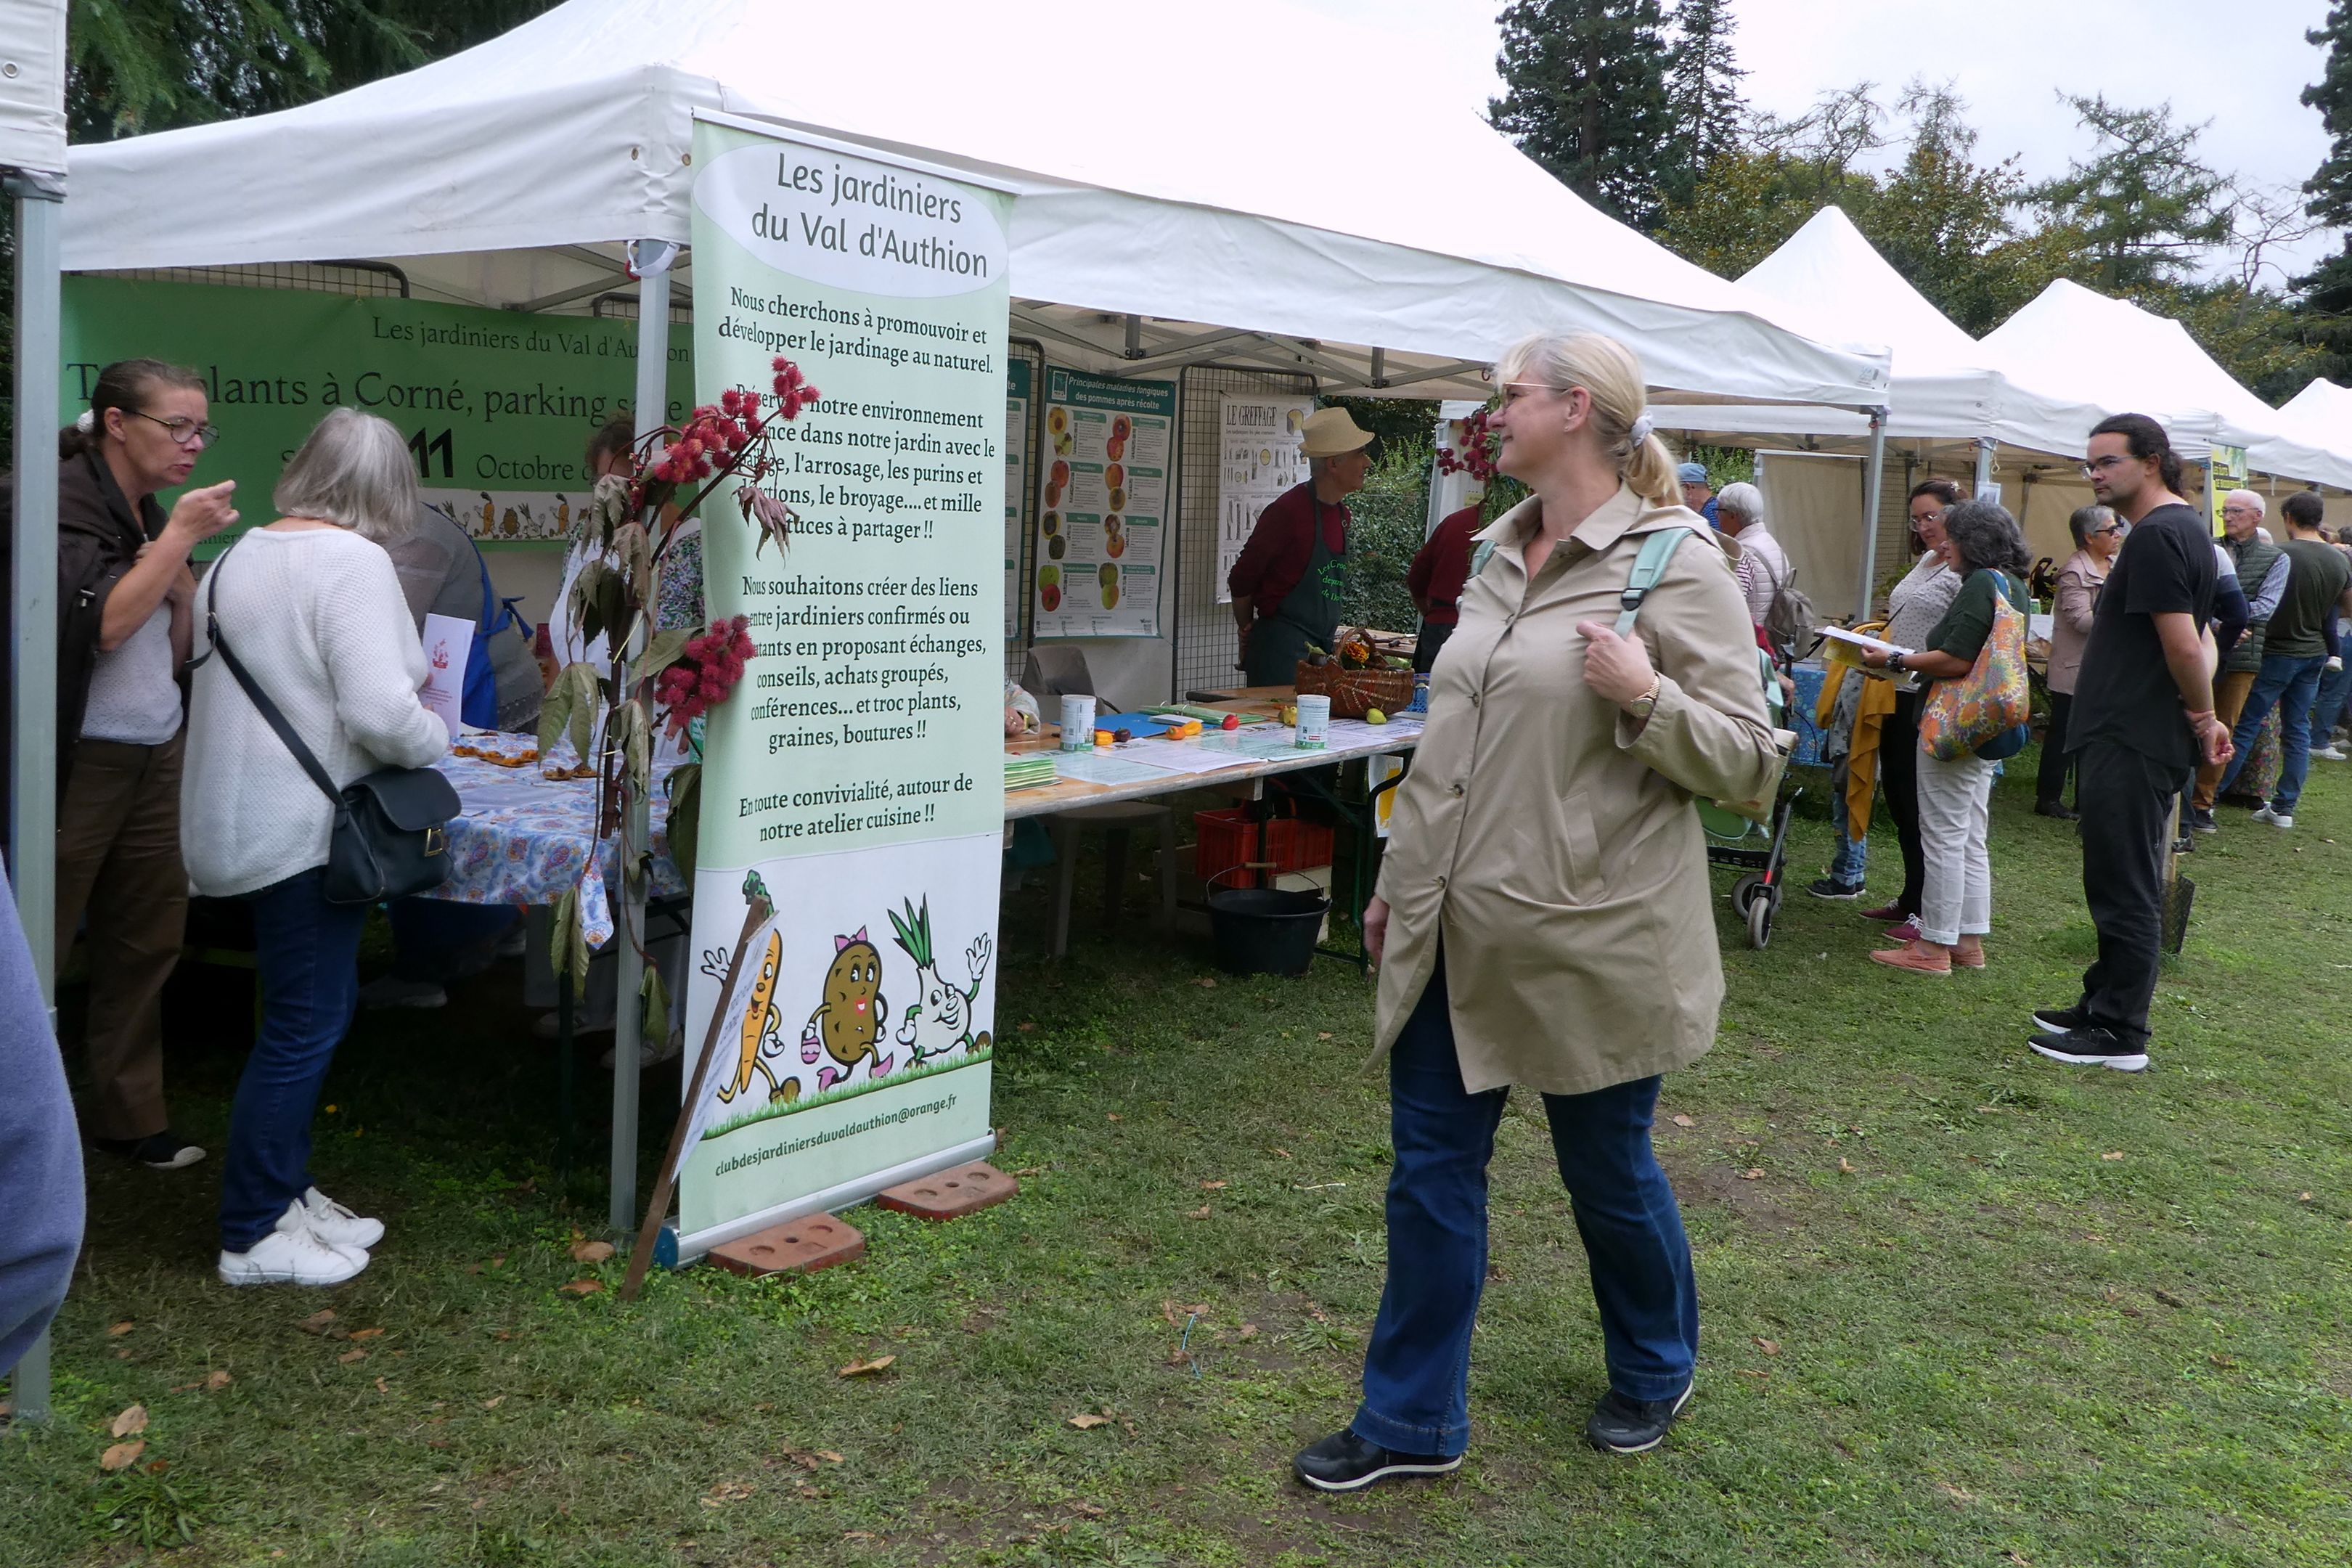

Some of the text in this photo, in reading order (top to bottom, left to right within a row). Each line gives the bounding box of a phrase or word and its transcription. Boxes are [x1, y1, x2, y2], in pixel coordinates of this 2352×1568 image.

[778, 153, 963, 223] Les jardiniers
[752, 203, 986, 277] du Val d'Authion
[731, 287, 987, 343] Nous cherchons à promouvoir et
[373, 317, 413, 340] Les
[421, 321, 521, 349] jardiniers
[526, 330, 550, 352] du
[558, 334, 589, 354] Val
[719, 317, 992, 373] développer le jardinage au naturel.
[211, 365, 309, 405] lants
[322, 372, 341, 405] à
[355, 372, 472, 417] Corné,
[484, 383, 607, 428] parking
[1069, 377, 1168, 396] Principales maladies fongiques
[1076, 392, 1087, 401] des
[1088, 395, 1116, 405] pommes
[1116, 398, 1135, 407] après
[1136, 401, 1159, 409] récolte
[809, 398, 858, 417] notre
[862, 401, 983, 428] environnement
[1227, 405, 1277, 426] LE GREFFAGE
[801, 422, 842, 444] dans
[848, 433, 890, 449] notre
[894, 430, 941, 455] jardin
[946, 442, 980, 456] avec
[984, 438, 994, 457] le
[477, 454, 573, 480] Octobre
[795, 452, 883, 483] l'arrosage,
[888, 460, 908, 479] les
[913, 464, 963, 486] purins
[968, 471, 982, 484] et
[820, 484, 834, 505] le
[924, 497, 937, 510] et
[942, 493, 981, 512] mille
[838, 516, 847, 535] à
[852, 523, 920, 543] partager
[925, 520, 932, 538] !!
[743, 575, 977, 596] Nous souhaitons créer des liens
[748, 605, 970, 631] entre jardiniers confirmés ou
[796, 642, 817, 656] en
[822, 640, 906, 661] proposant
[910, 634, 985, 658] échanges,
[758, 663, 948, 688] conseils, achats groupés,
[751, 691, 960, 720] conférences... et troc plants,
[769, 720, 926, 754] graines, boutures !!
[739, 773, 972, 817] En toute convivialité, autour de
[761, 804, 934, 841] notre atelier cuisine !!
[716, 1094, 956, 1176] clubdesjardiniersduvaldauthion@orange.fr
